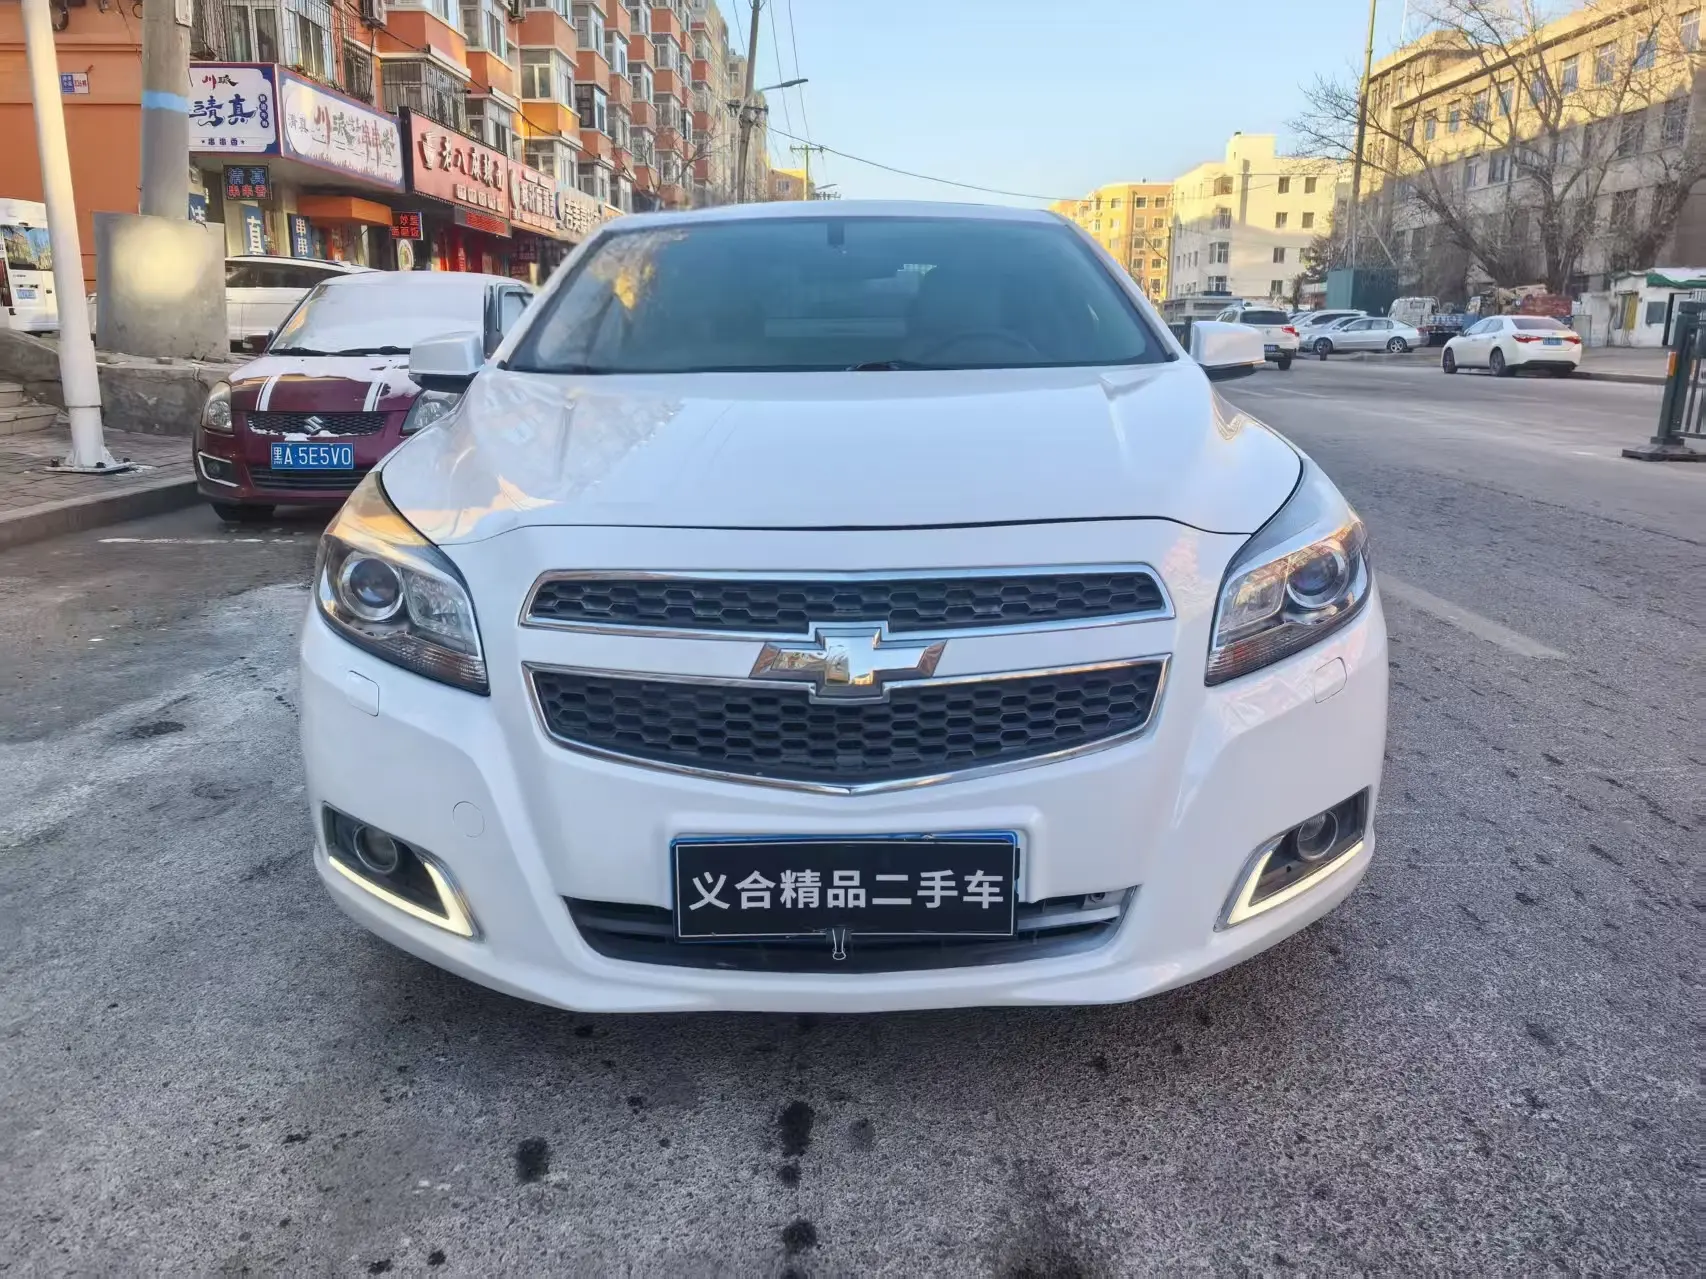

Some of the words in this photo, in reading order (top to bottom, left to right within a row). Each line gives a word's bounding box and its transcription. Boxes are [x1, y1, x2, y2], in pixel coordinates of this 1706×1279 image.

[188, 93, 259, 127] 清真
[228, 167, 266, 185] 清真
[688, 868, 1005, 911] 义合精品二手车
